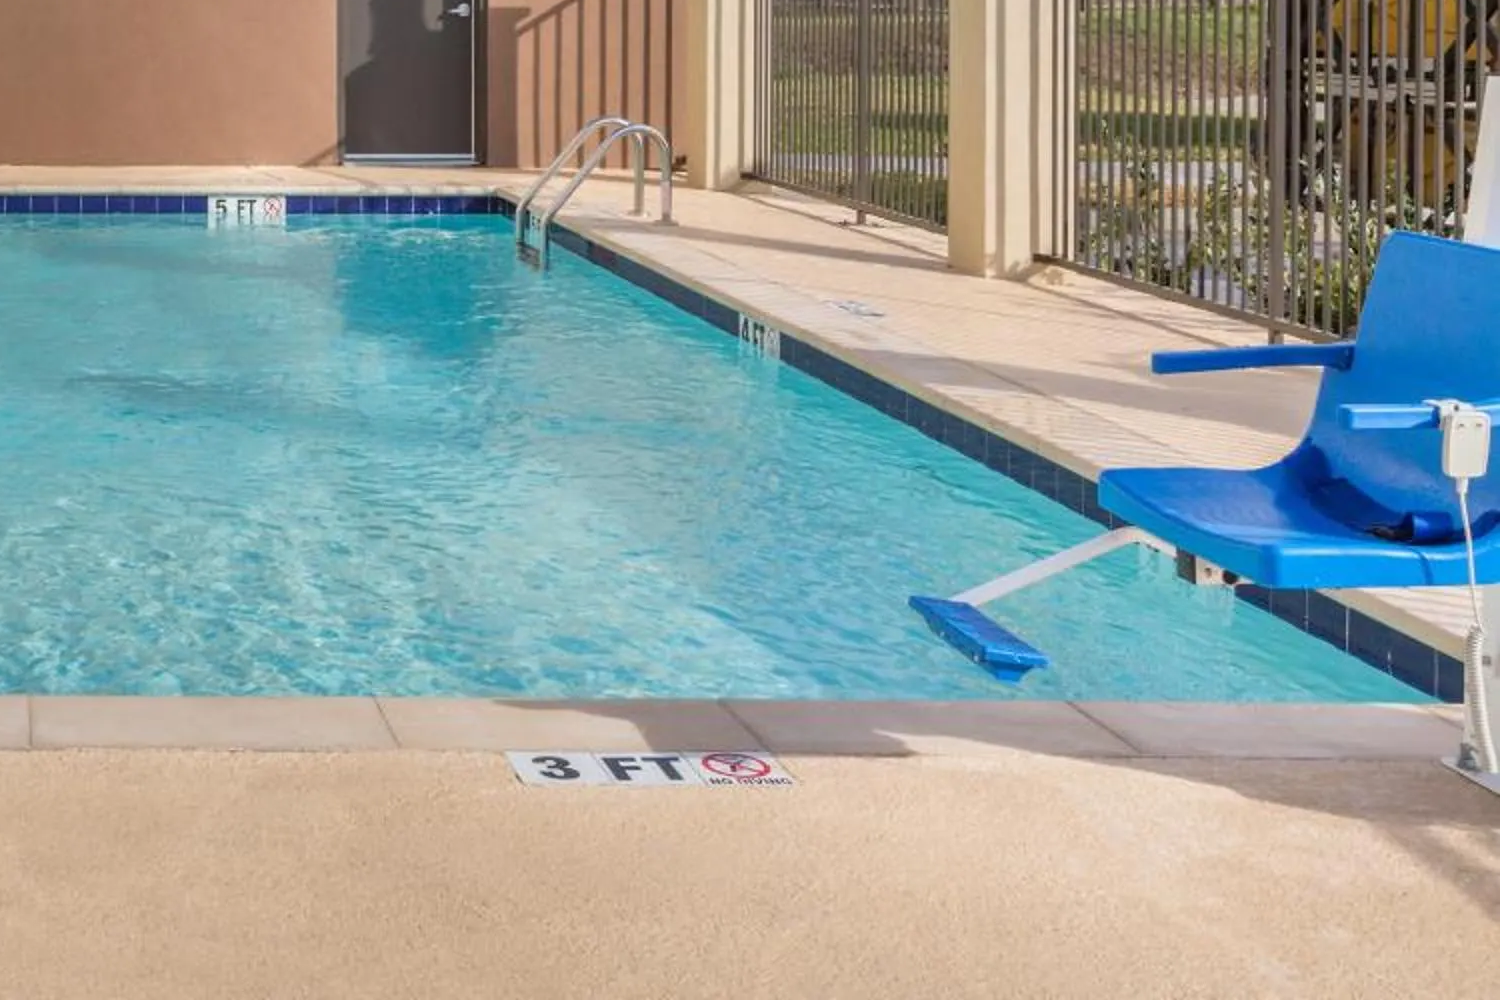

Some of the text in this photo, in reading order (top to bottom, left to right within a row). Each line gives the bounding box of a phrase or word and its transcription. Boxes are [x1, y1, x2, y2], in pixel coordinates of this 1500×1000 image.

[214, 199, 258, 217] 5 FT
[531, 755, 685, 781] 3 FT
[709, 777, 733, 785] NO
